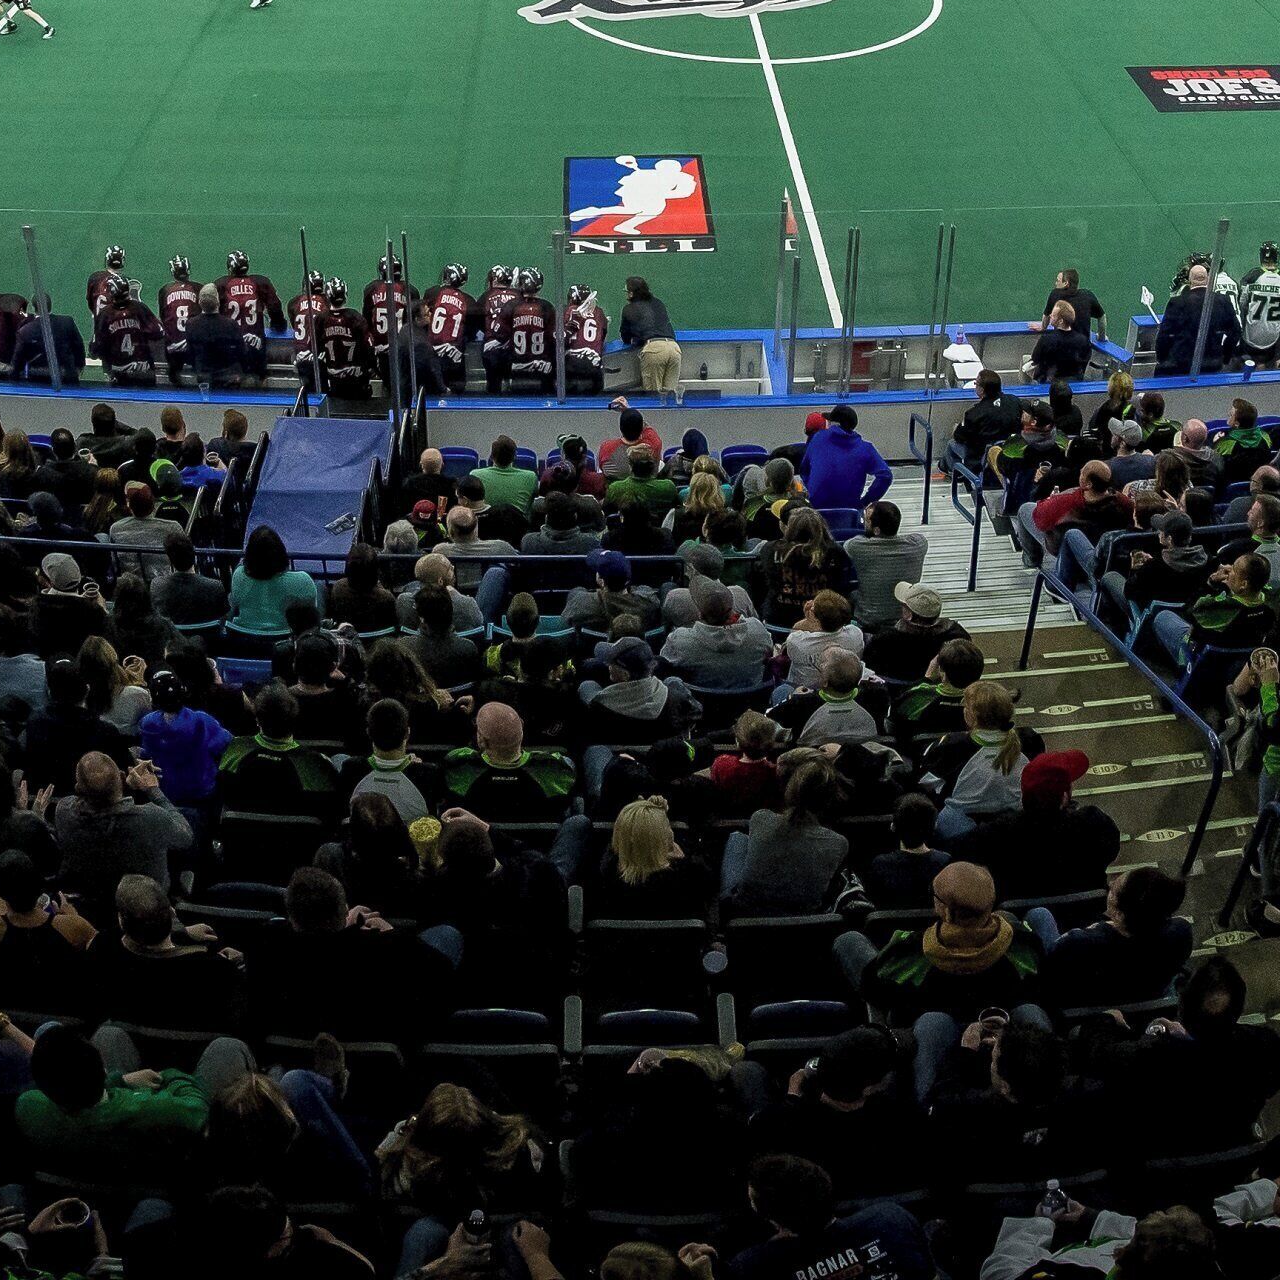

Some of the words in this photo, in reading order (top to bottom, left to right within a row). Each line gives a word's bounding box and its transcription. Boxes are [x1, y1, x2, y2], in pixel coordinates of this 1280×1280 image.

[1150, 70, 1271, 80] SHOELESS
[569, 239, 715, 252] NLL
[167, 290, 196, 304] DOWNING
[230, 284, 253, 296] GILLES
[441, 294, 463, 309] BURKE
[176, 306, 189, 332] 8
[228, 299, 257, 326] 23
[376, 308, 404, 334] 51
[109, 318, 140, 333] SULLIVAN
[325, 326, 352, 337] WARDLE
[431, 307, 463, 338] 61
[121, 334, 133, 355] 4
[325, 341, 356, 362] 17
[513, 331, 545, 355] 98
[1214, 936, 1221, 944] E
[1225, 935, 1236, 943] 12
[1239, 933, 1245, 941] D
[795, 1247, 859, 1280] RAGNAR
